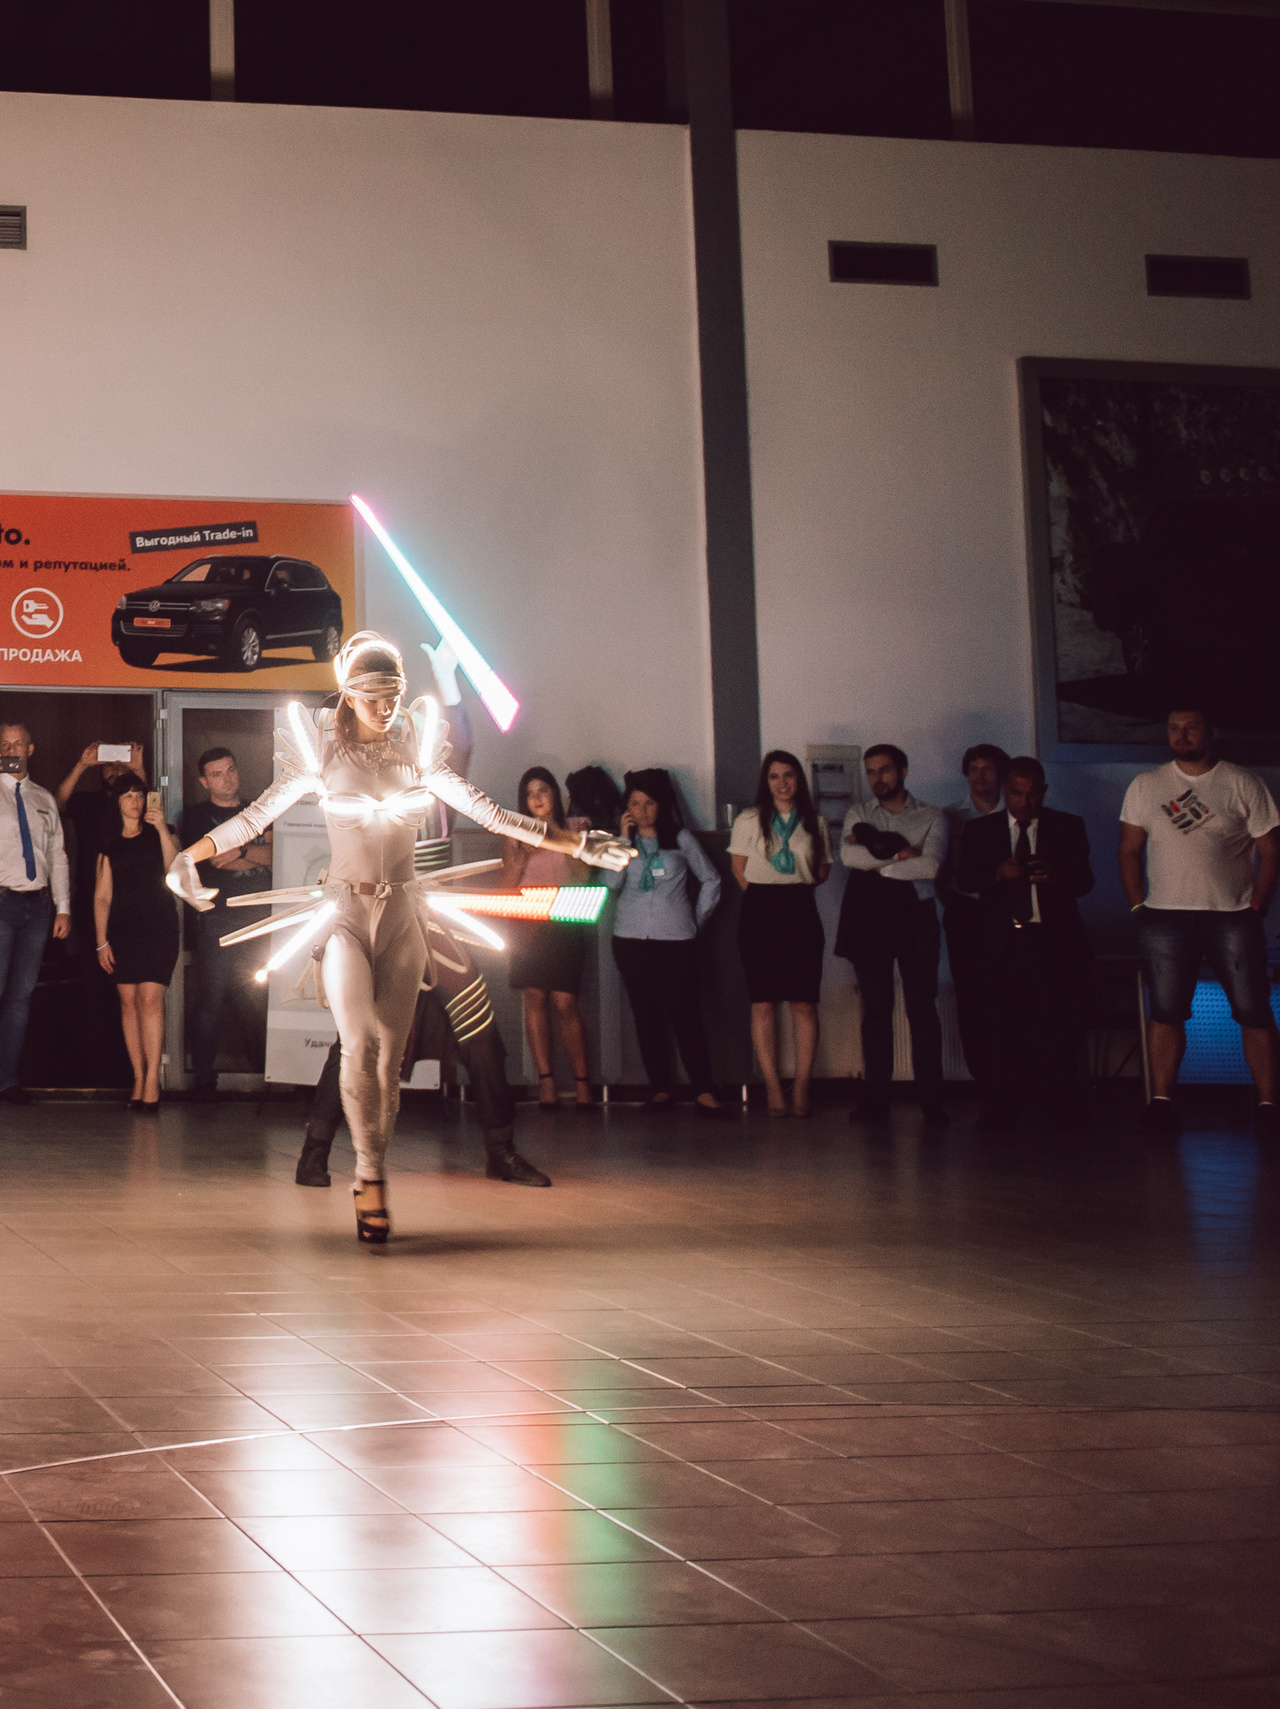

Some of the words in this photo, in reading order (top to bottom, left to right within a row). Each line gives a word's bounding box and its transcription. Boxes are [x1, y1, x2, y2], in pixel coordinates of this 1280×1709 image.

[136, 532, 201, 548] Выгодный
[203, 527, 253, 541] Trade-in
[20, 559, 28, 568] и
[33, 559, 132, 573] репутацией.
